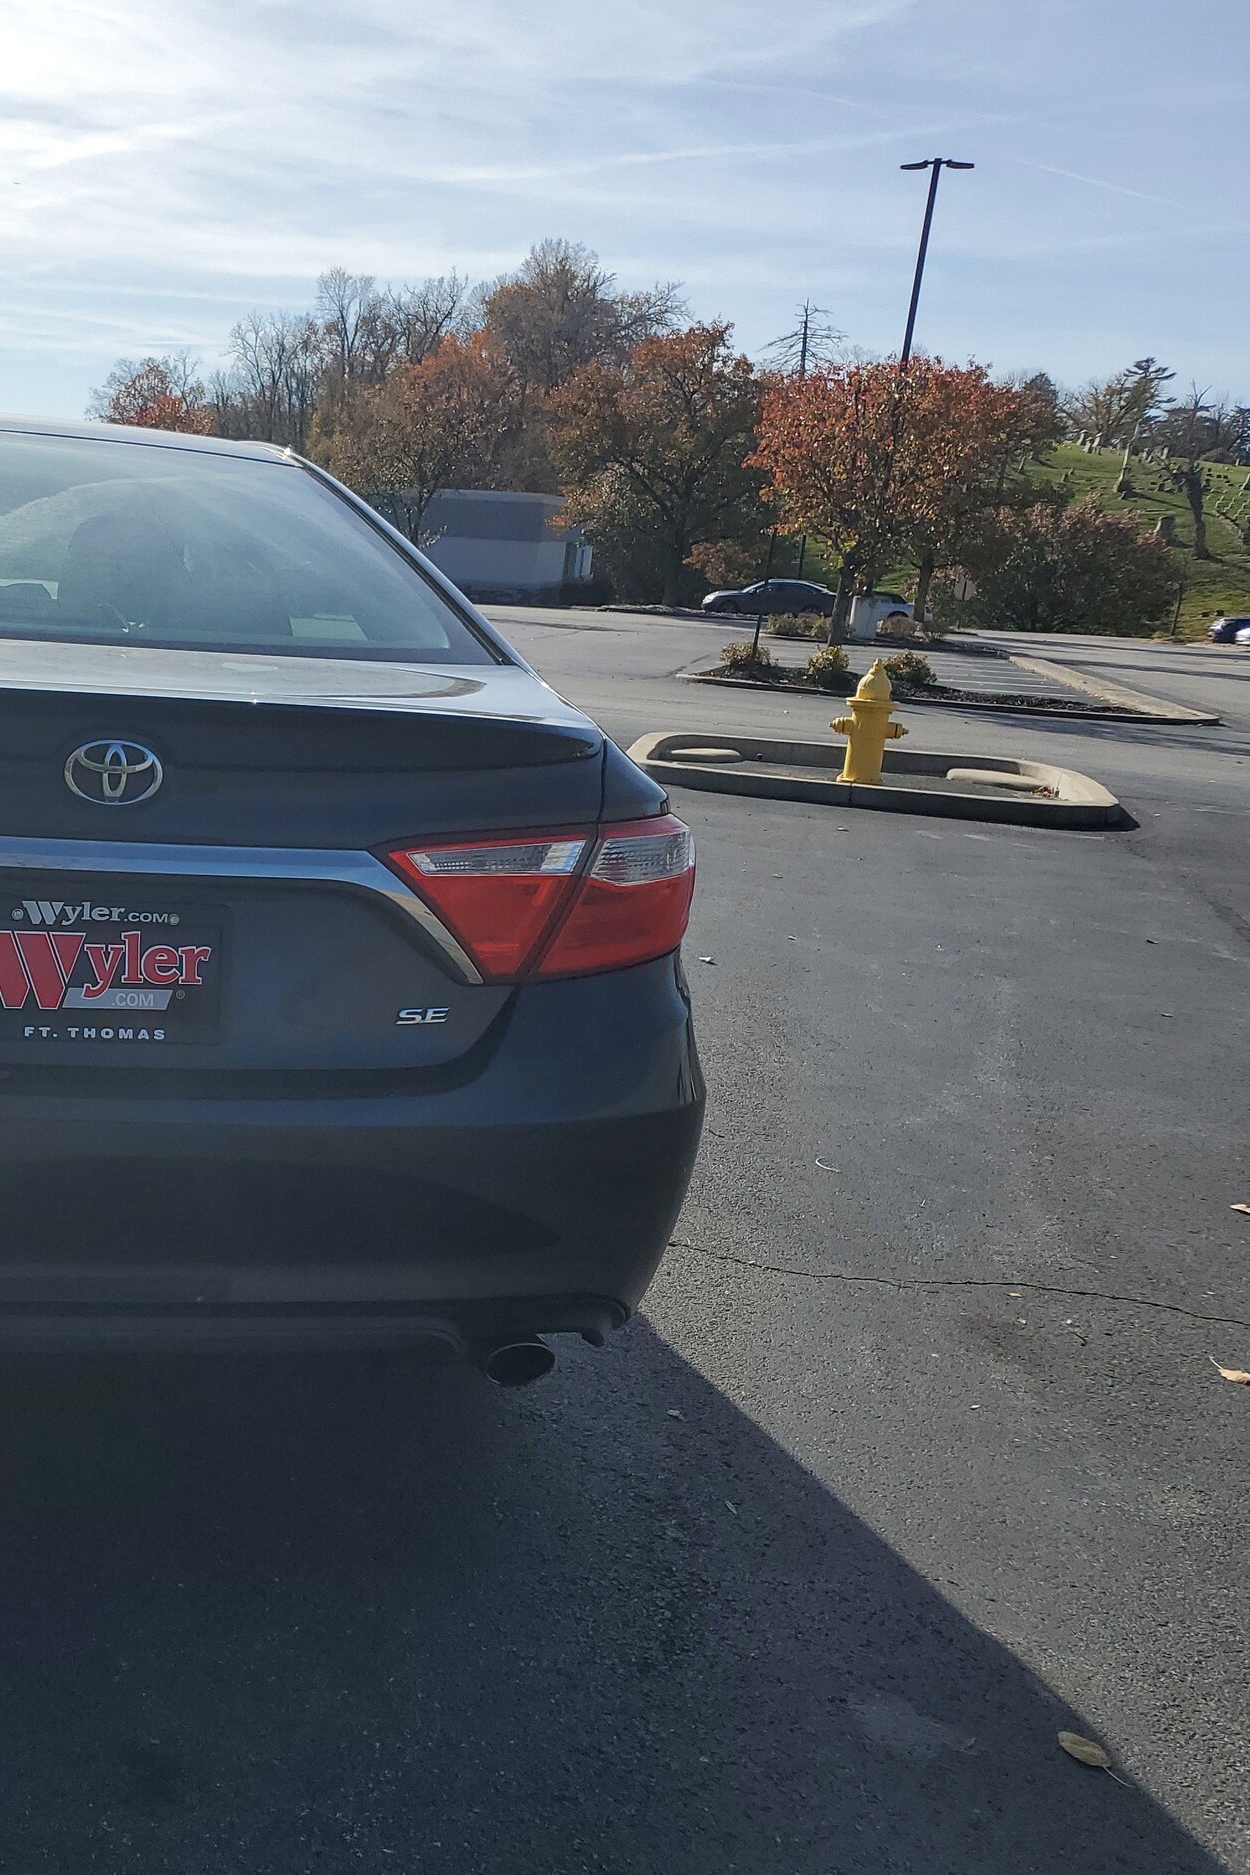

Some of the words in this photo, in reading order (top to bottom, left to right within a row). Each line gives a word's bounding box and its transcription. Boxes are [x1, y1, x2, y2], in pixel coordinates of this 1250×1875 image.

[396, 1007, 450, 1025] SE
[24, 1026, 58, 1038] FT.
[67, 1027, 166, 1040] THOMAS
